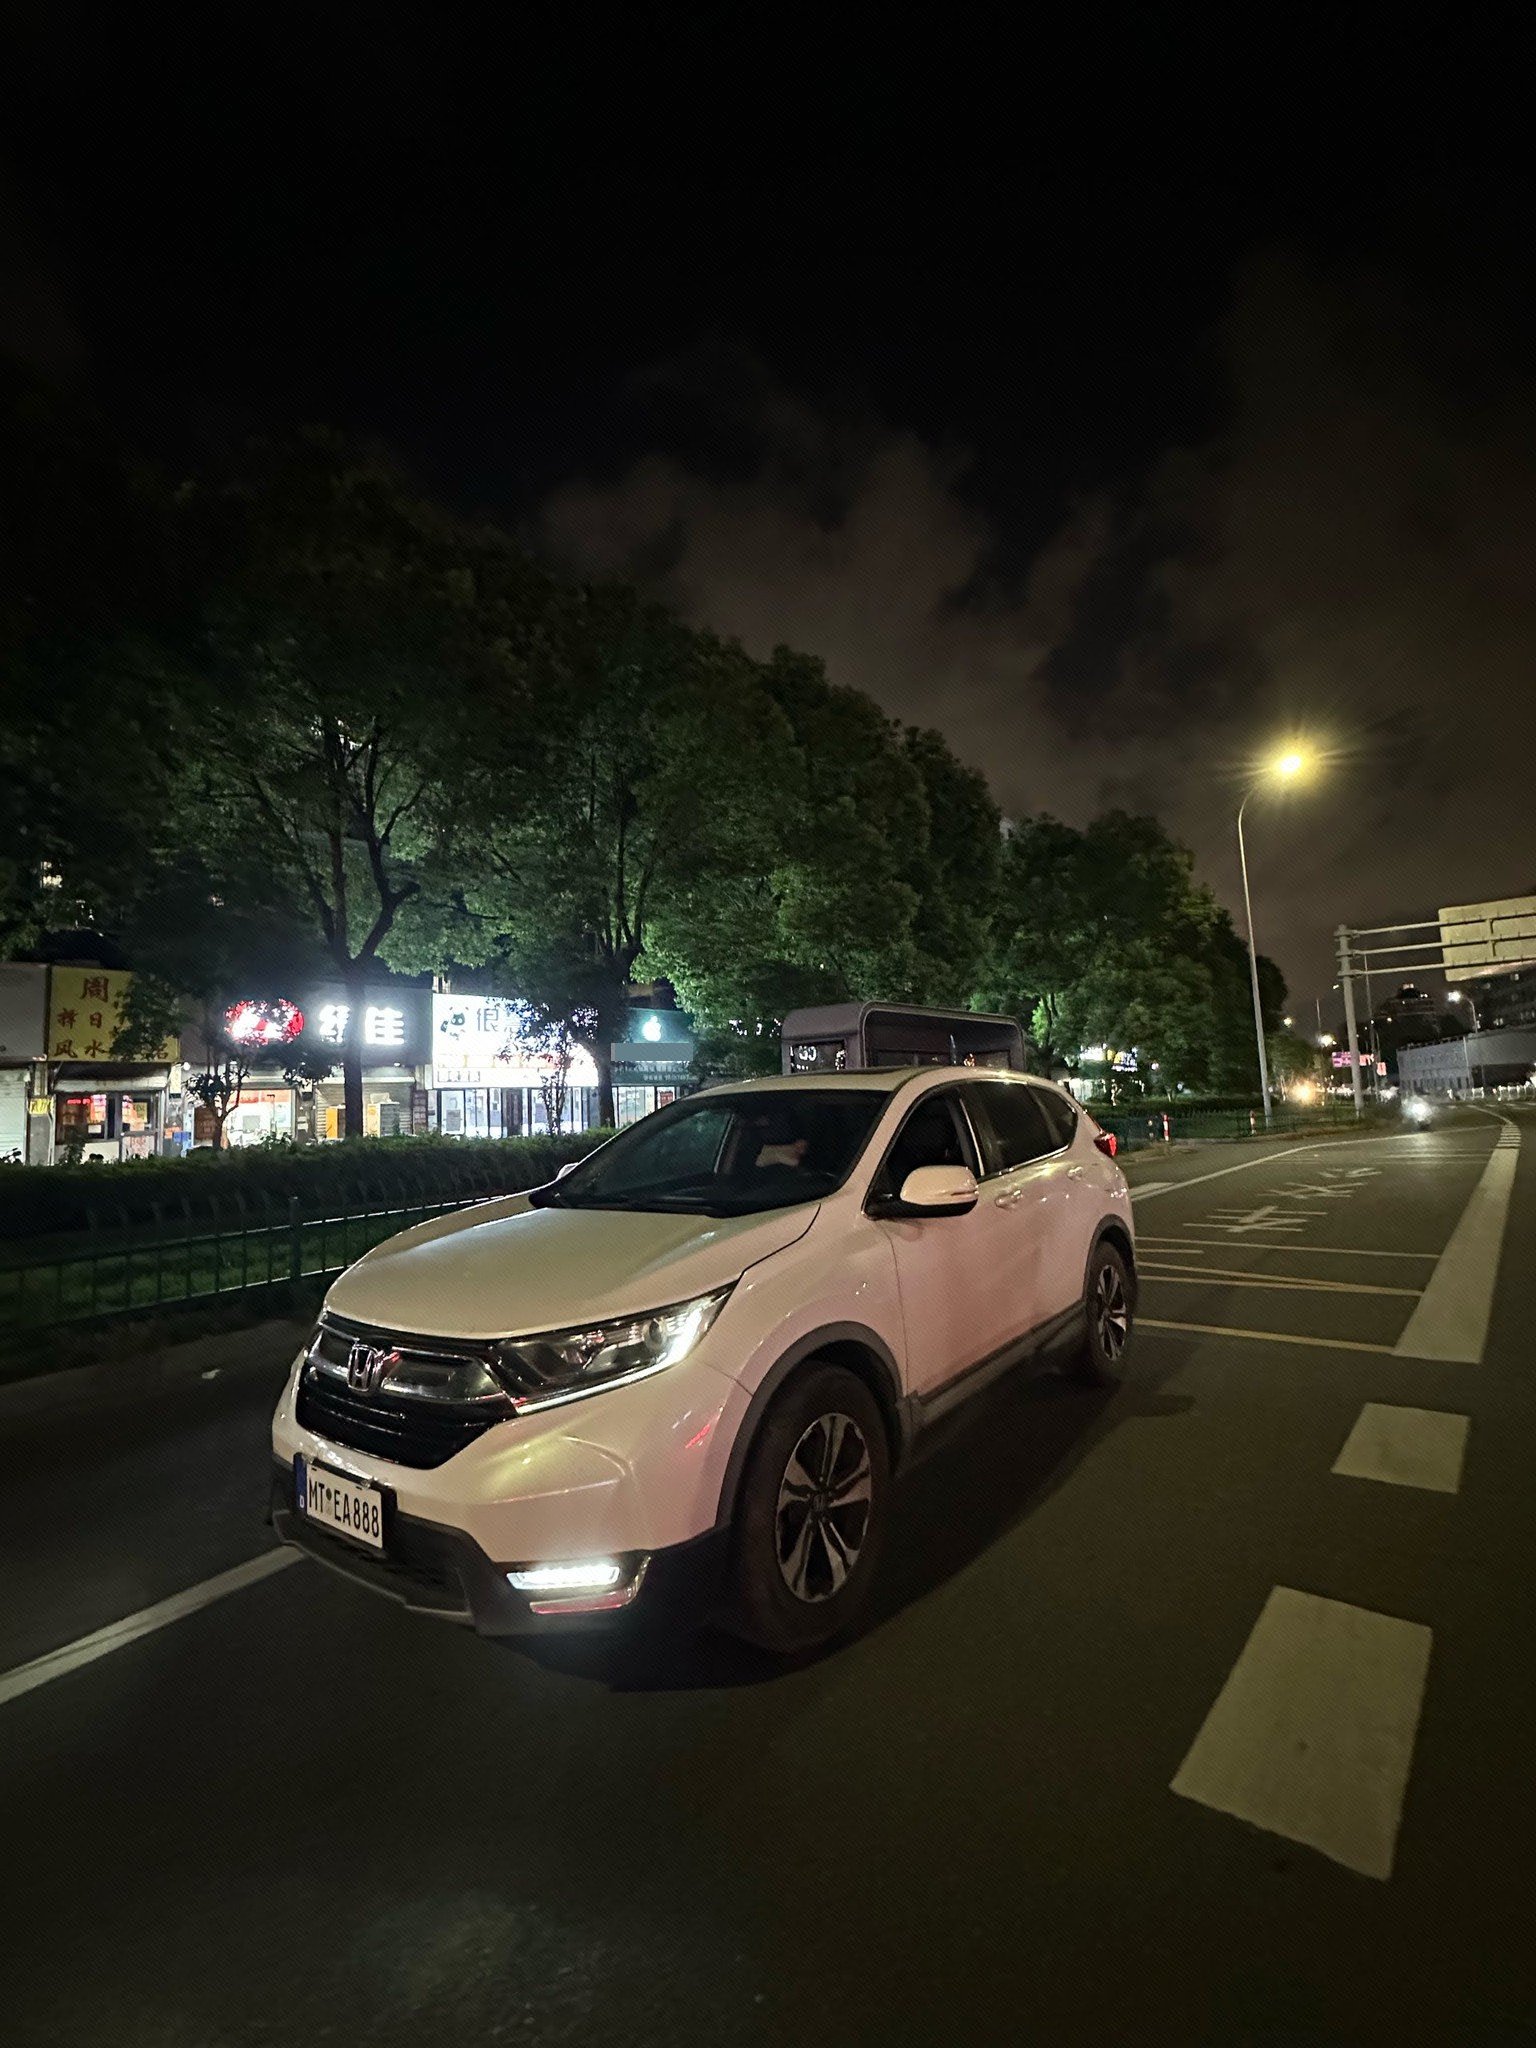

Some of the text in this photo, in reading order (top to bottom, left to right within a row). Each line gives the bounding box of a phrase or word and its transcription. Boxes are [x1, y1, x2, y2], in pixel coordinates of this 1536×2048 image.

[53, 1039, 109, 1059] 风水
[309, 1479, 379, 1537] MT EA888
